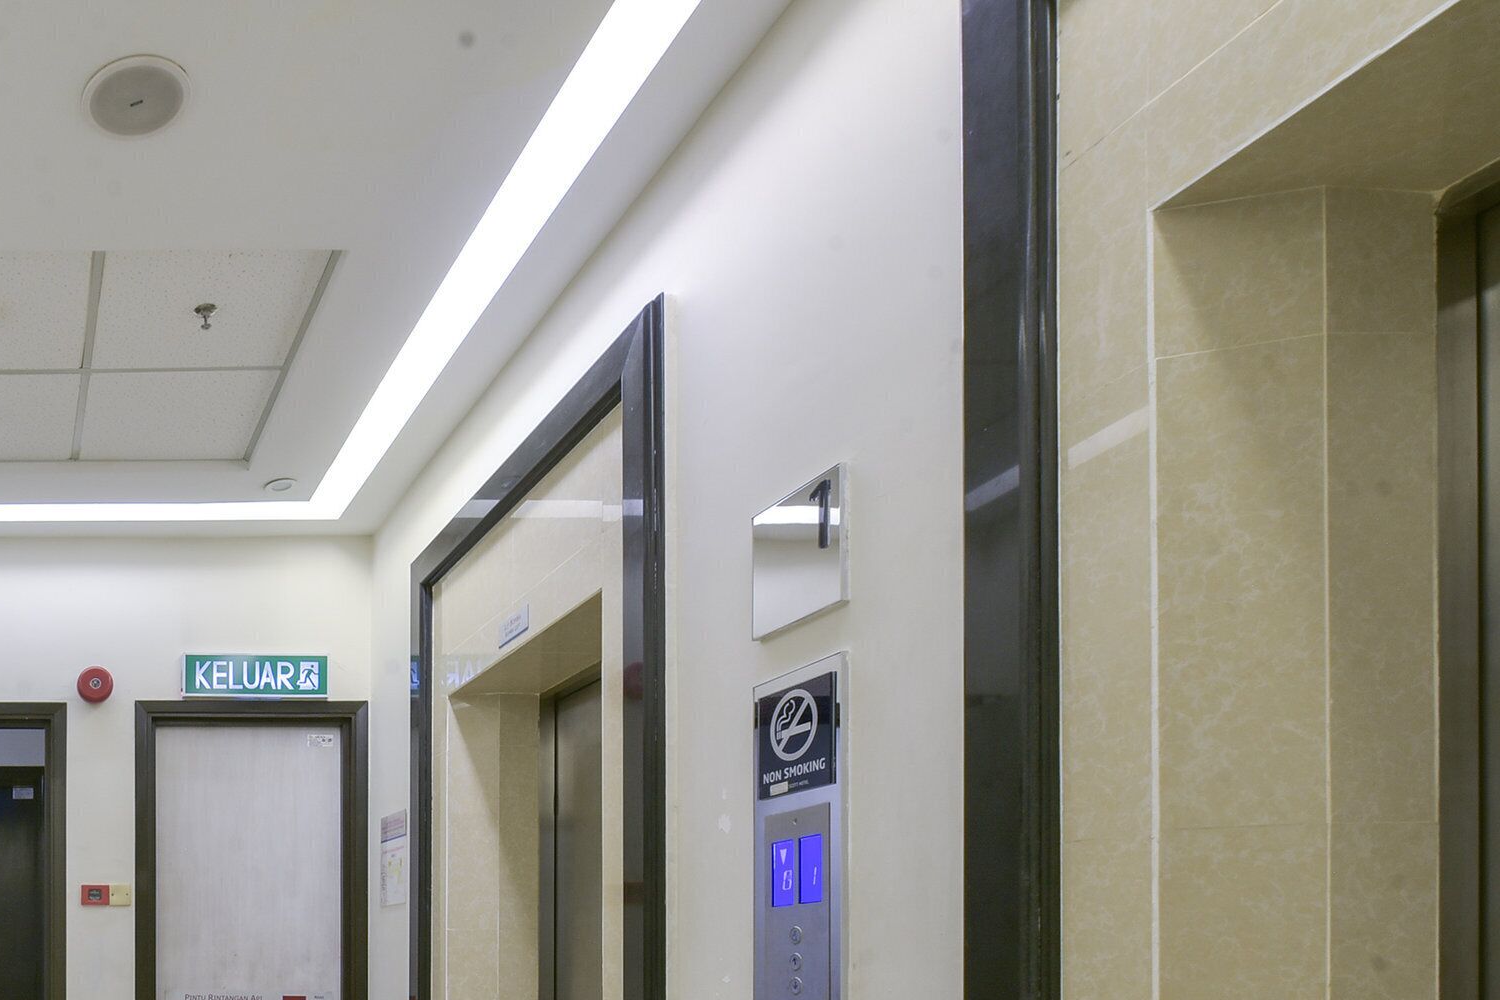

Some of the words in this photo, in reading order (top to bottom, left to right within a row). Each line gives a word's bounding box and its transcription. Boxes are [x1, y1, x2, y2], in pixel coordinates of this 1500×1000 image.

[195, 660, 295, 690] KELUAR
[763, 769, 782, 784] NON
[784, 757, 826, 779] SMOKING
[184, 993, 206, 1000] PINTU
